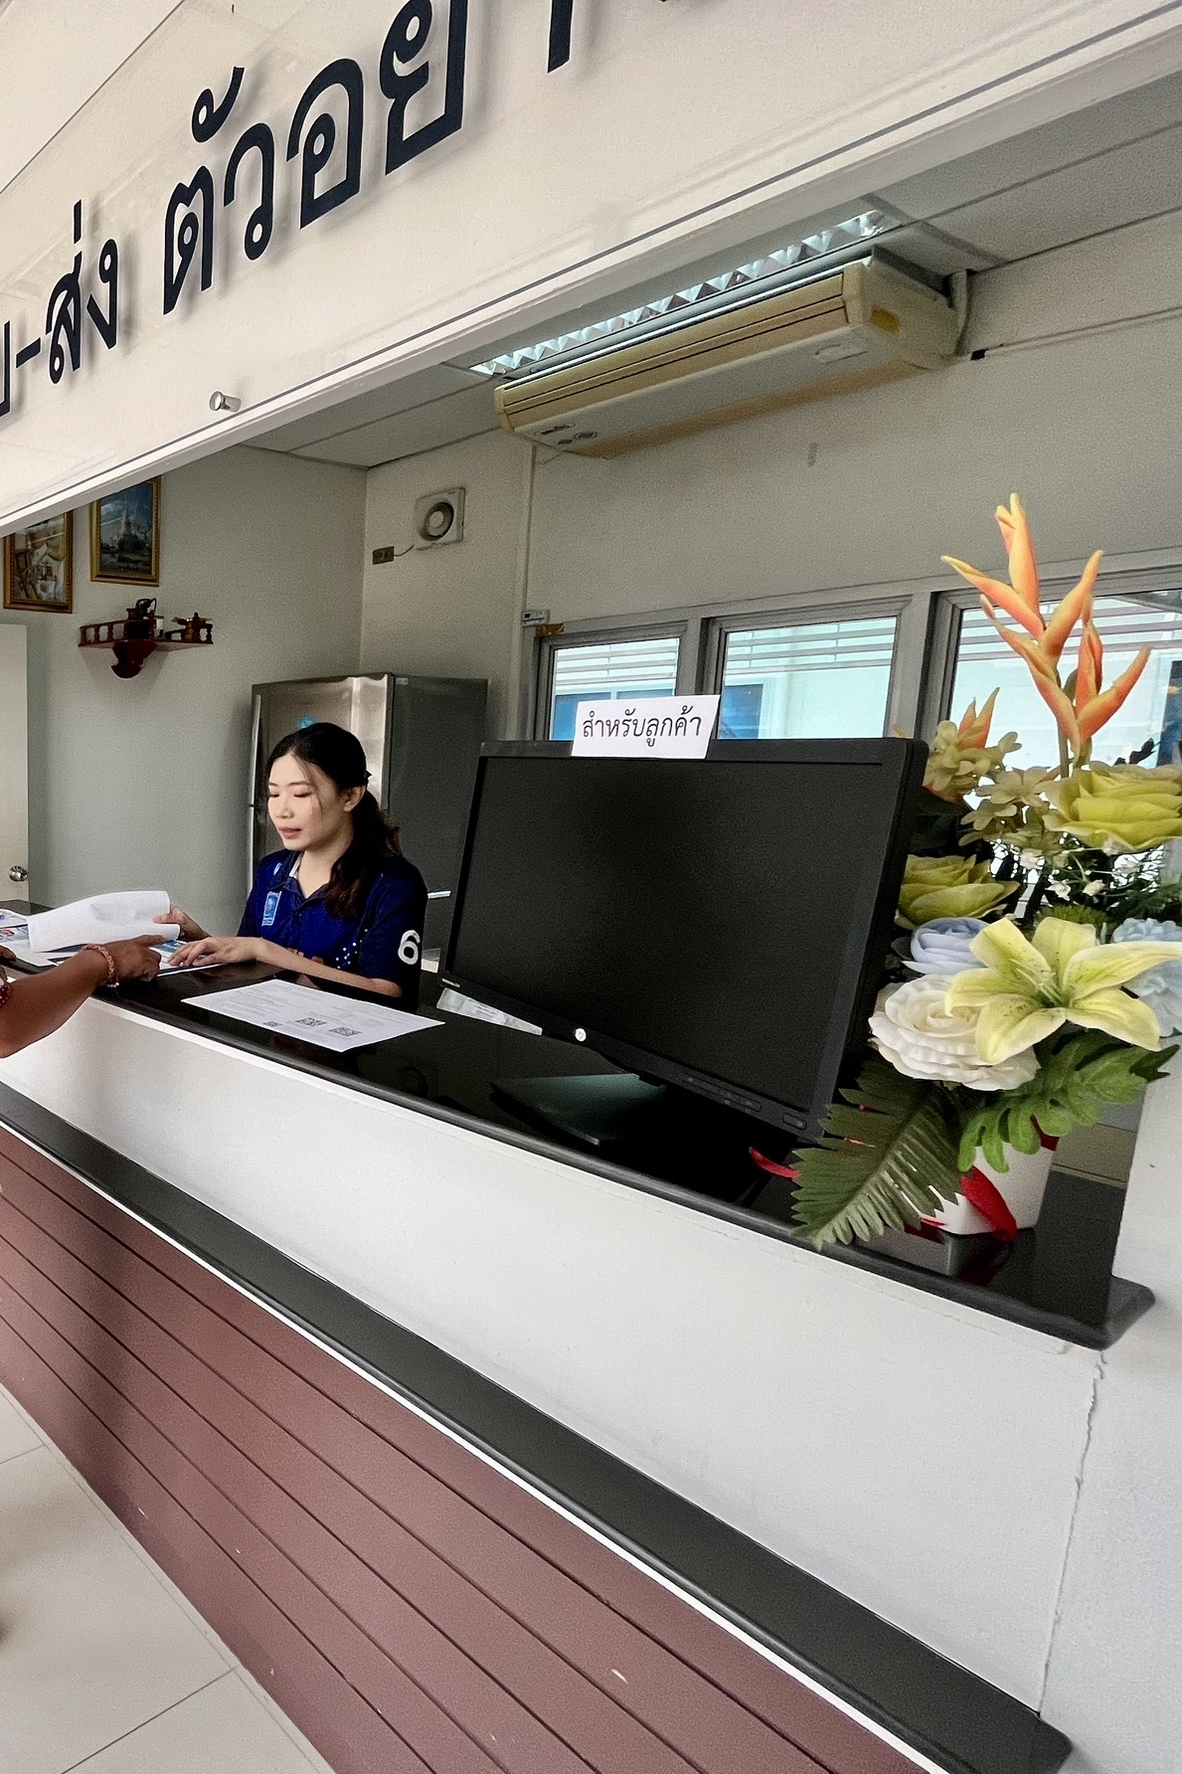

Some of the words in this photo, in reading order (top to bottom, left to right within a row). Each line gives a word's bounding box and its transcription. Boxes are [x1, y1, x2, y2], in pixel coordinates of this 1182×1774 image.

[582, 705, 703, 747] สำหรับลูกค้า
[397, 929, 422, 966] 6
